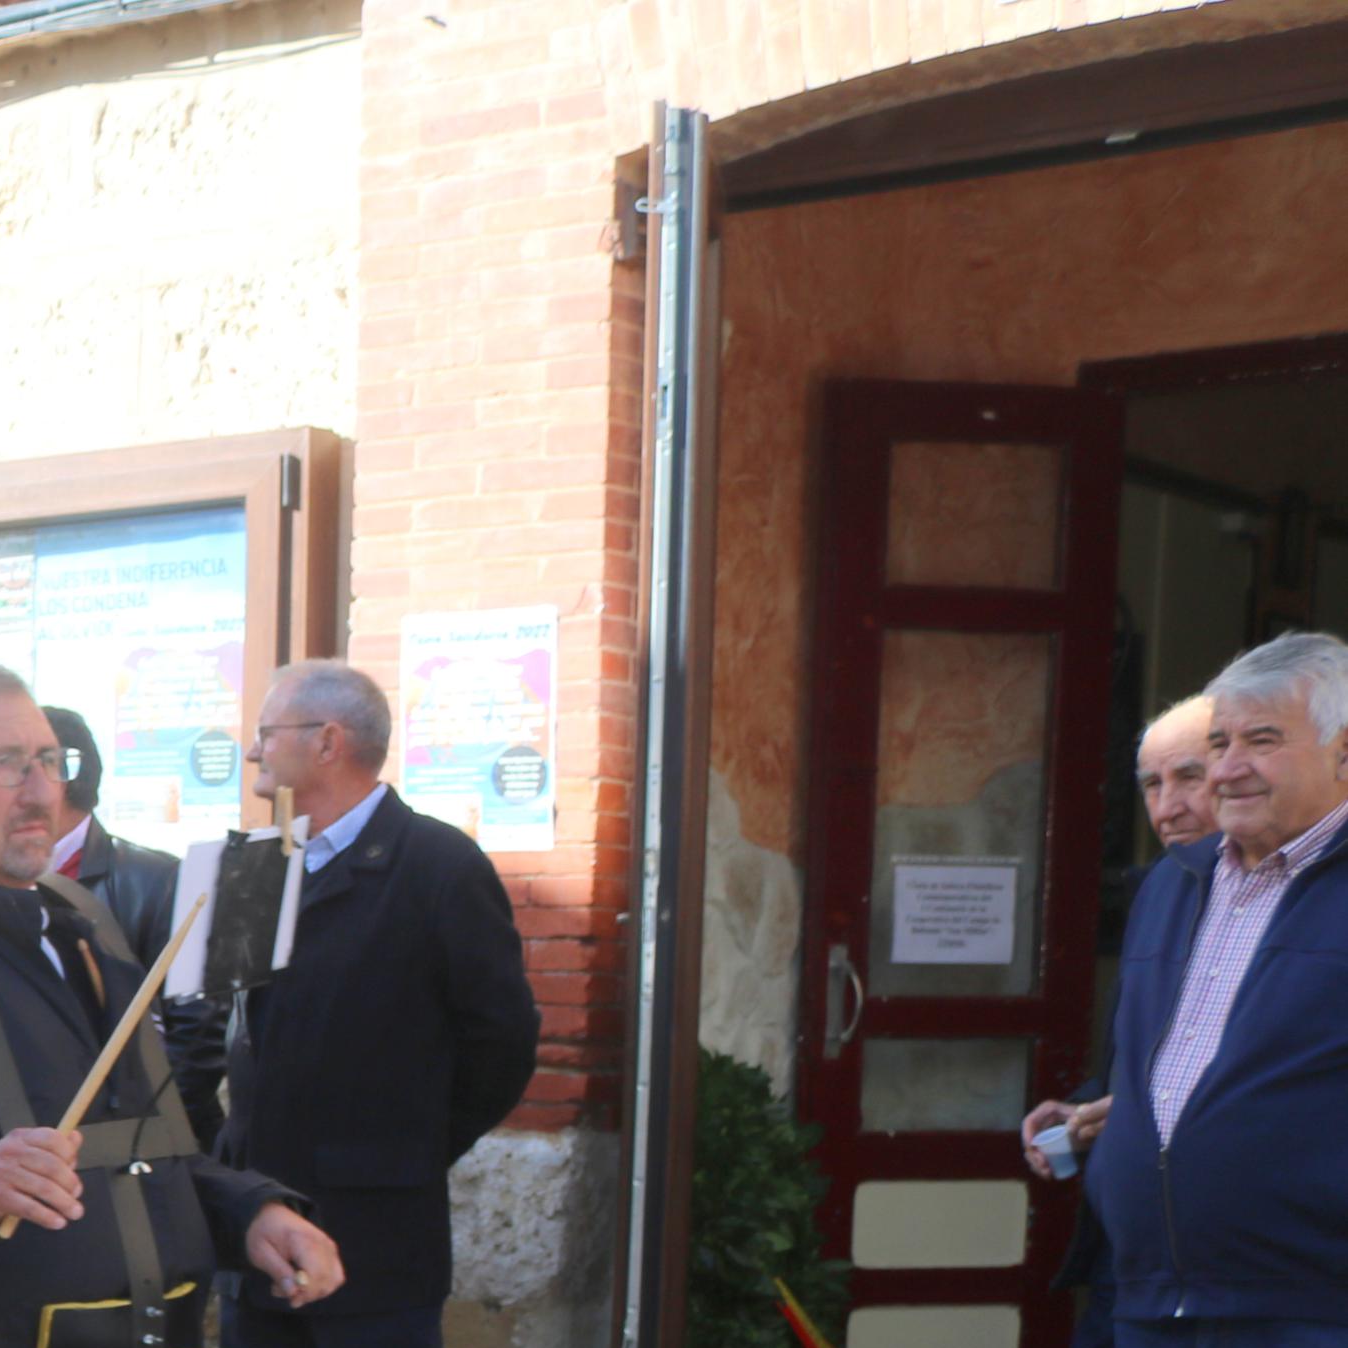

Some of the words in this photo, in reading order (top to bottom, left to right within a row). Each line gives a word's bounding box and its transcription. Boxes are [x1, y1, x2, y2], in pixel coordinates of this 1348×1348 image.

[40, 570, 111, 591] NUESTRA
[116, 557, 228, 584] INDIFERENCIA
[37, 597, 68, 616] LOS
[72, 591, 149, 614] CONDENA
